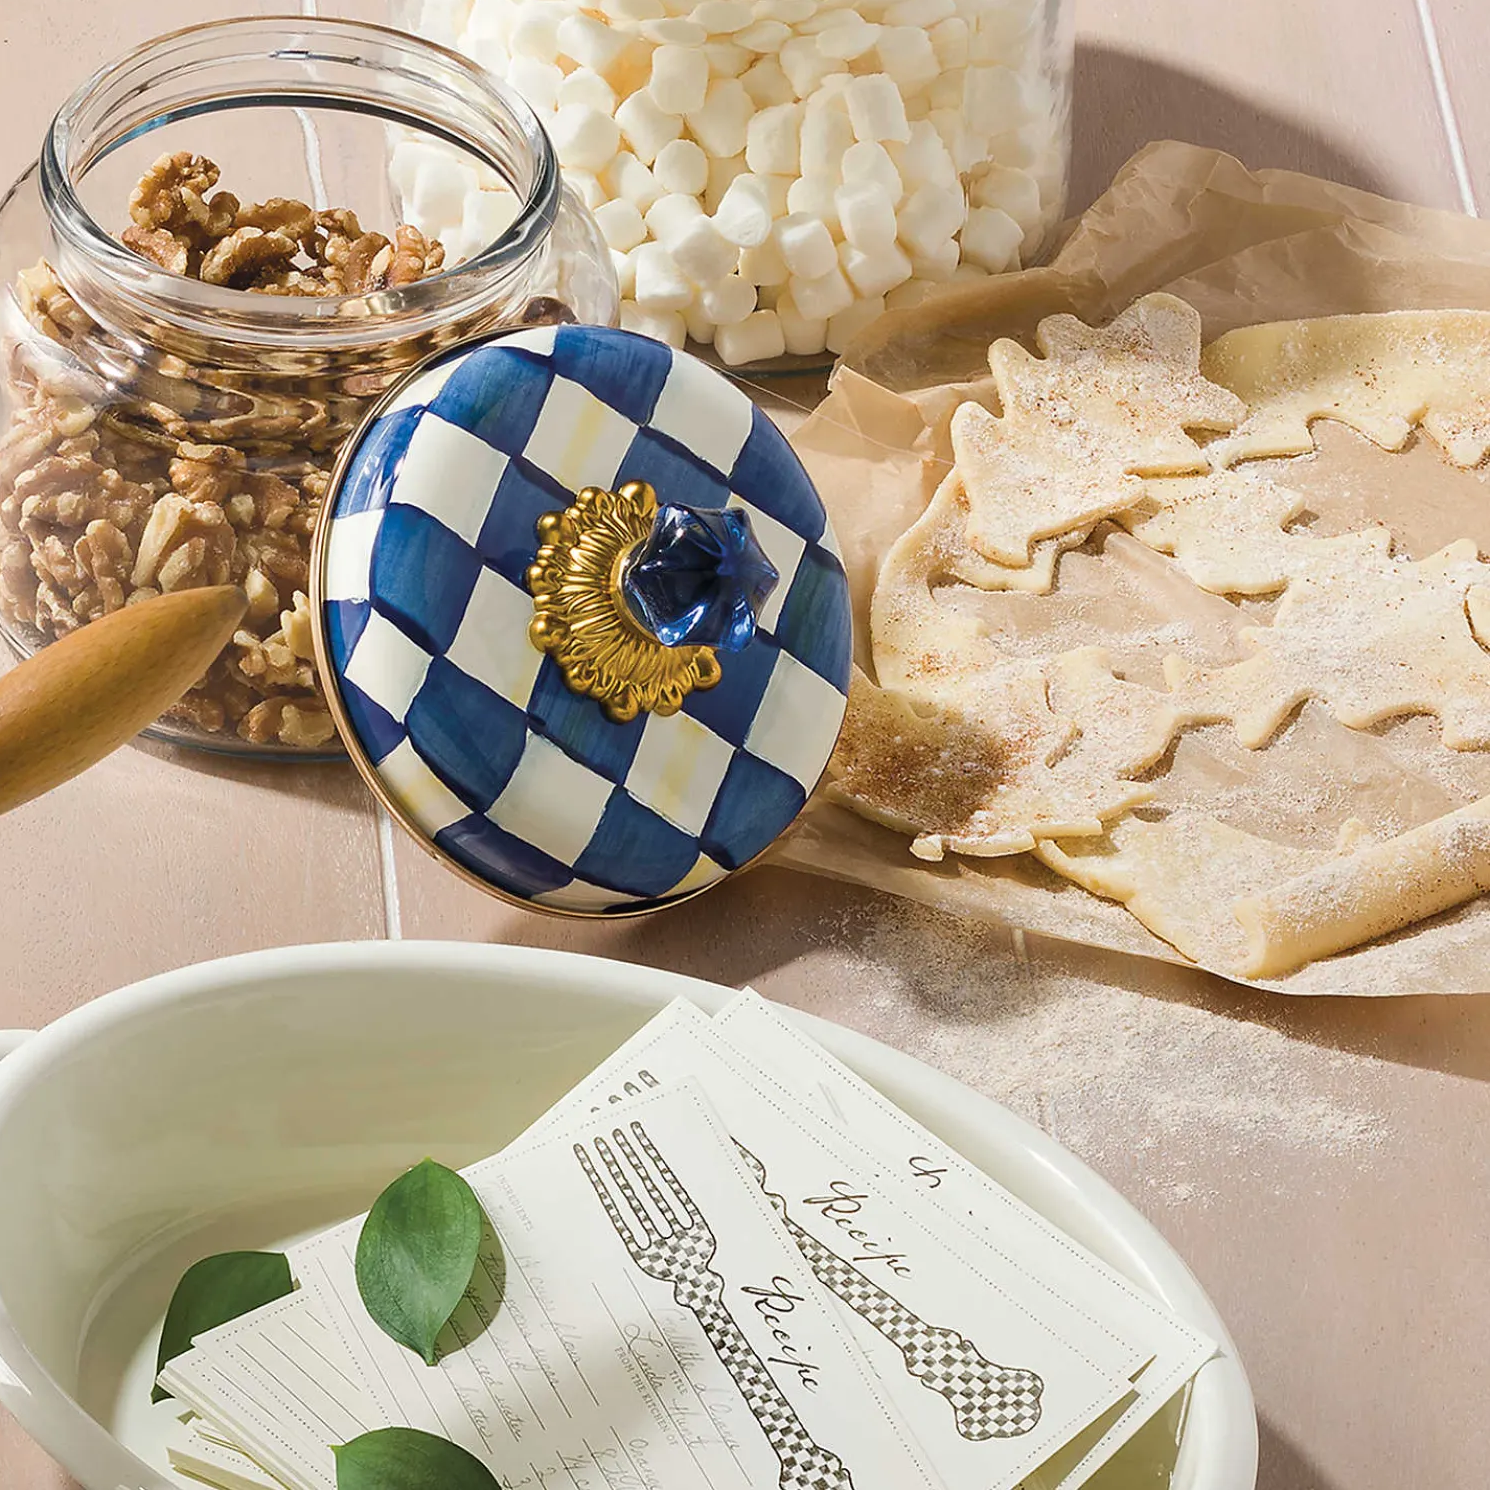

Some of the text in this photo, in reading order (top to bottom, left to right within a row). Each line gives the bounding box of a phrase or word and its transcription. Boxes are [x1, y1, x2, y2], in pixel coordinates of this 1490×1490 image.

[802, 1179, 916, 1281] Recipe
[740, 1275, 823, 1392] Recipe
[614, 1346, 635, 1376] FROM
[630, 1373, 647, 1394] THE
[641, 1392, 669, 1433] KITCHEN
[668, 1369, 689, 1396] TITLE
